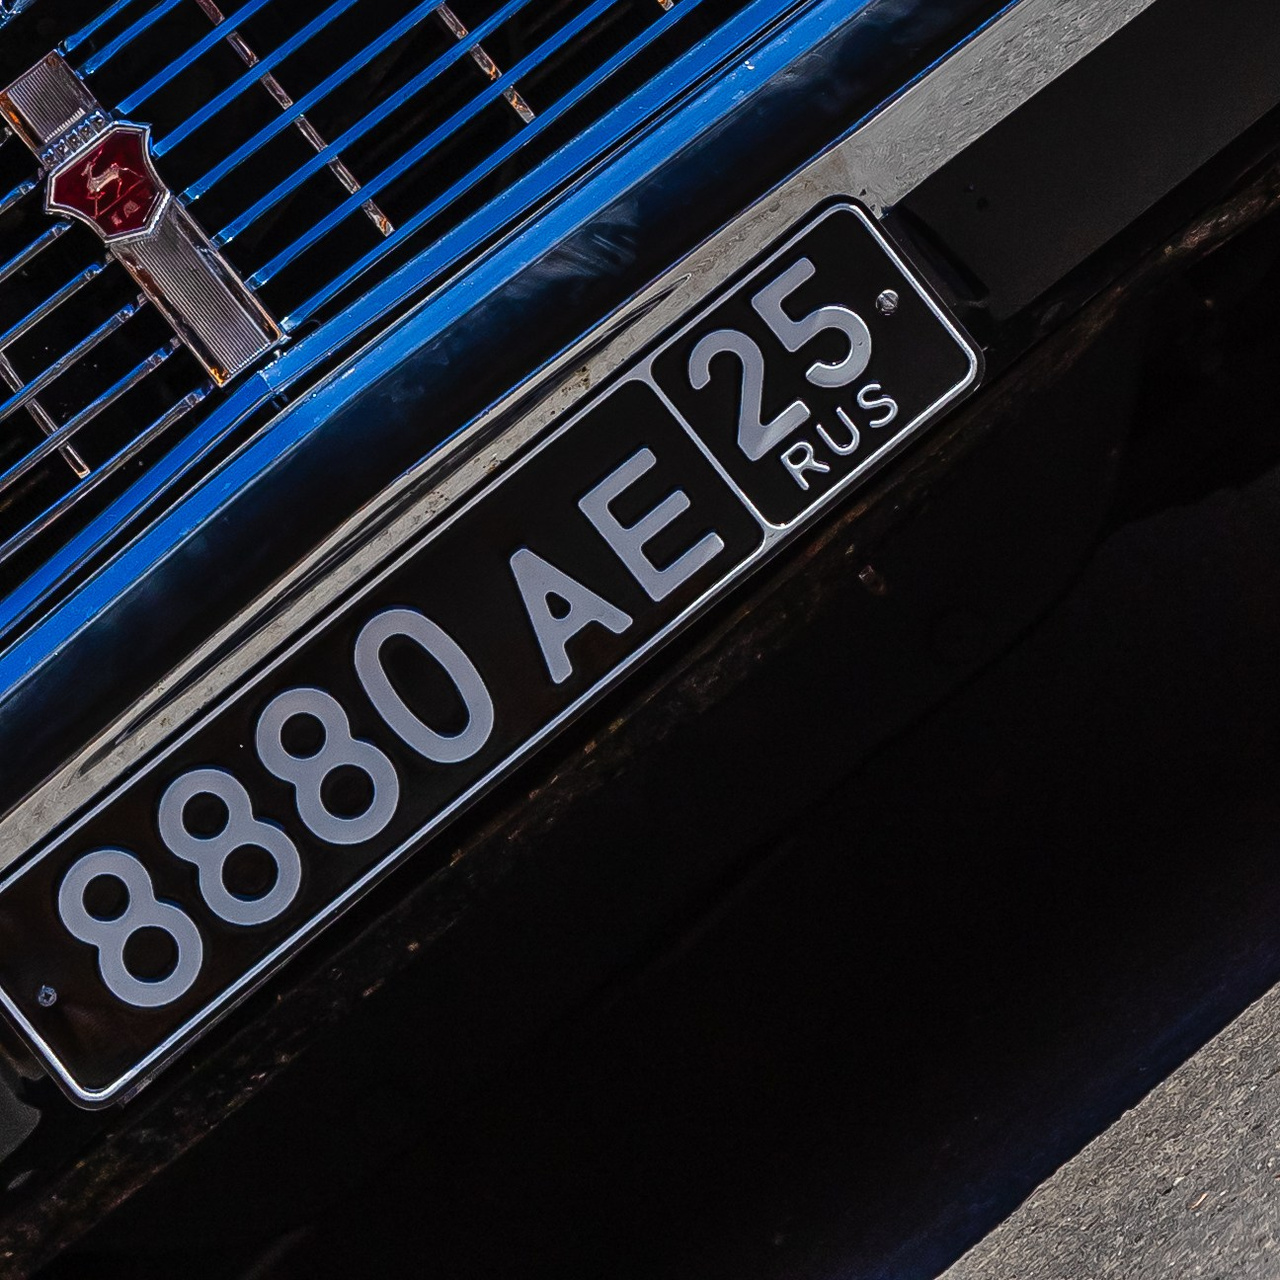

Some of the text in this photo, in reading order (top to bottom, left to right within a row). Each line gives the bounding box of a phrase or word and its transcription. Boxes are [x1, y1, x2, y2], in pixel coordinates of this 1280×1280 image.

[57, 608, 495, 1008] 8880
[687, 256, 872, 462] 25
[780, 381, 902, 491] RUS
